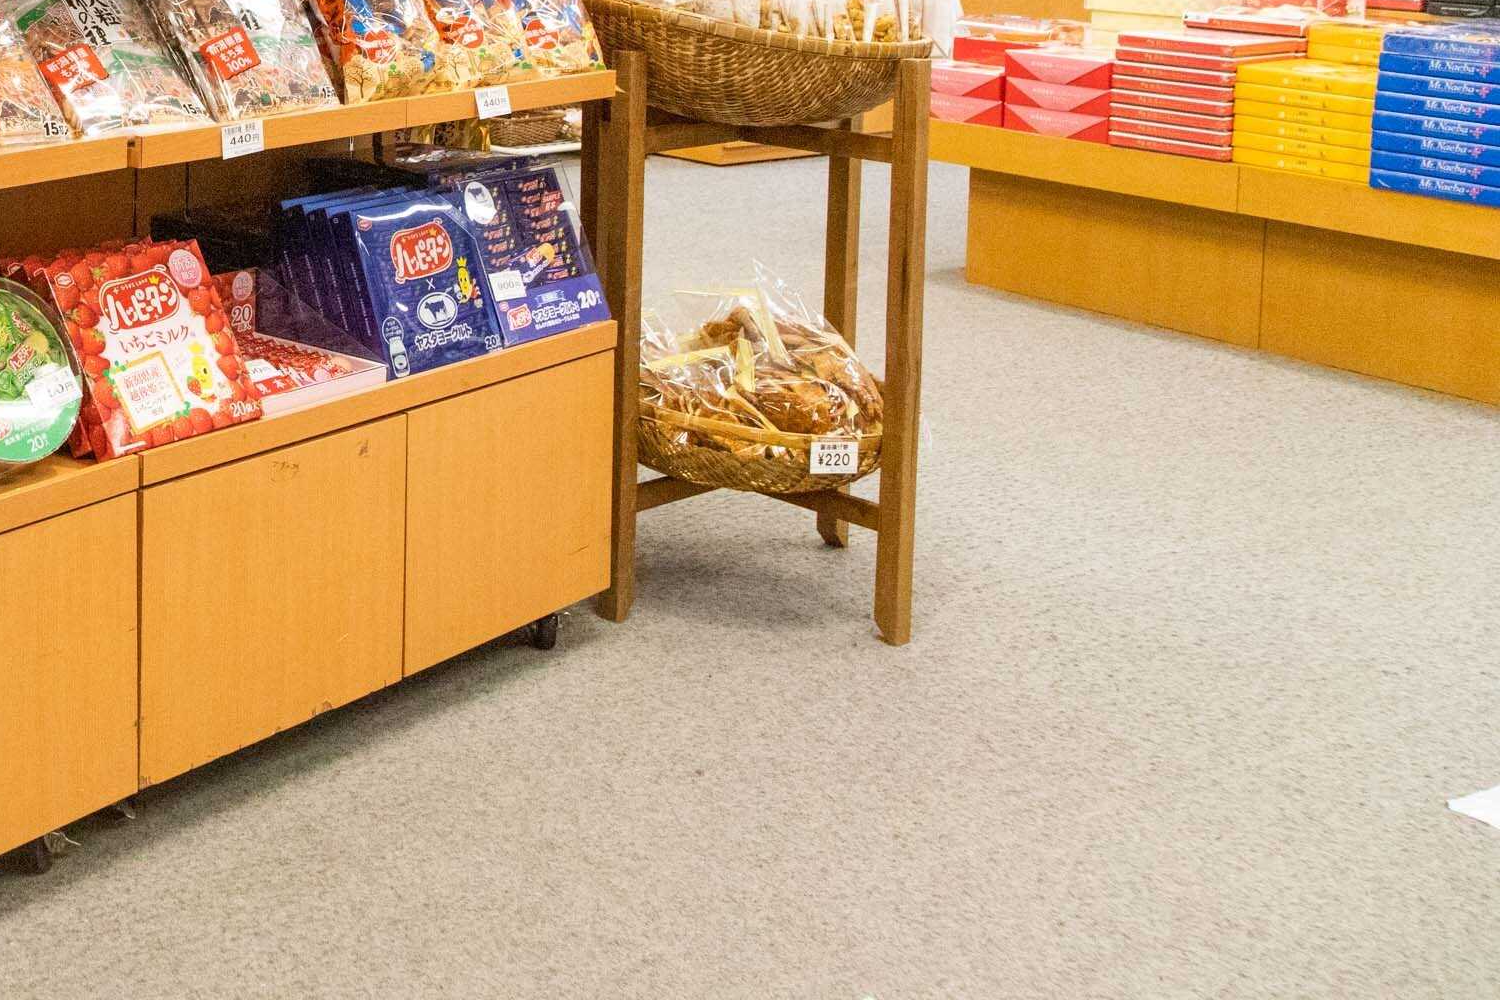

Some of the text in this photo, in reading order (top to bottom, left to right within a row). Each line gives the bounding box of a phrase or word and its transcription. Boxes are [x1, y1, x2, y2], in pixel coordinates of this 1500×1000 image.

[208, 34, 245, 57] 新潟県産
[220, 46, 245, 62] もち米
[226, 57, 252, 72] 100%
[229, 133, 260, 146] 440円
[231, 304, 253, 326] 20
[120, 325, 189, 353] いちごミルク
[414, 322, 473, 352] ヤスダヨーグルト
[818, 452, 851, 467] ¥220
